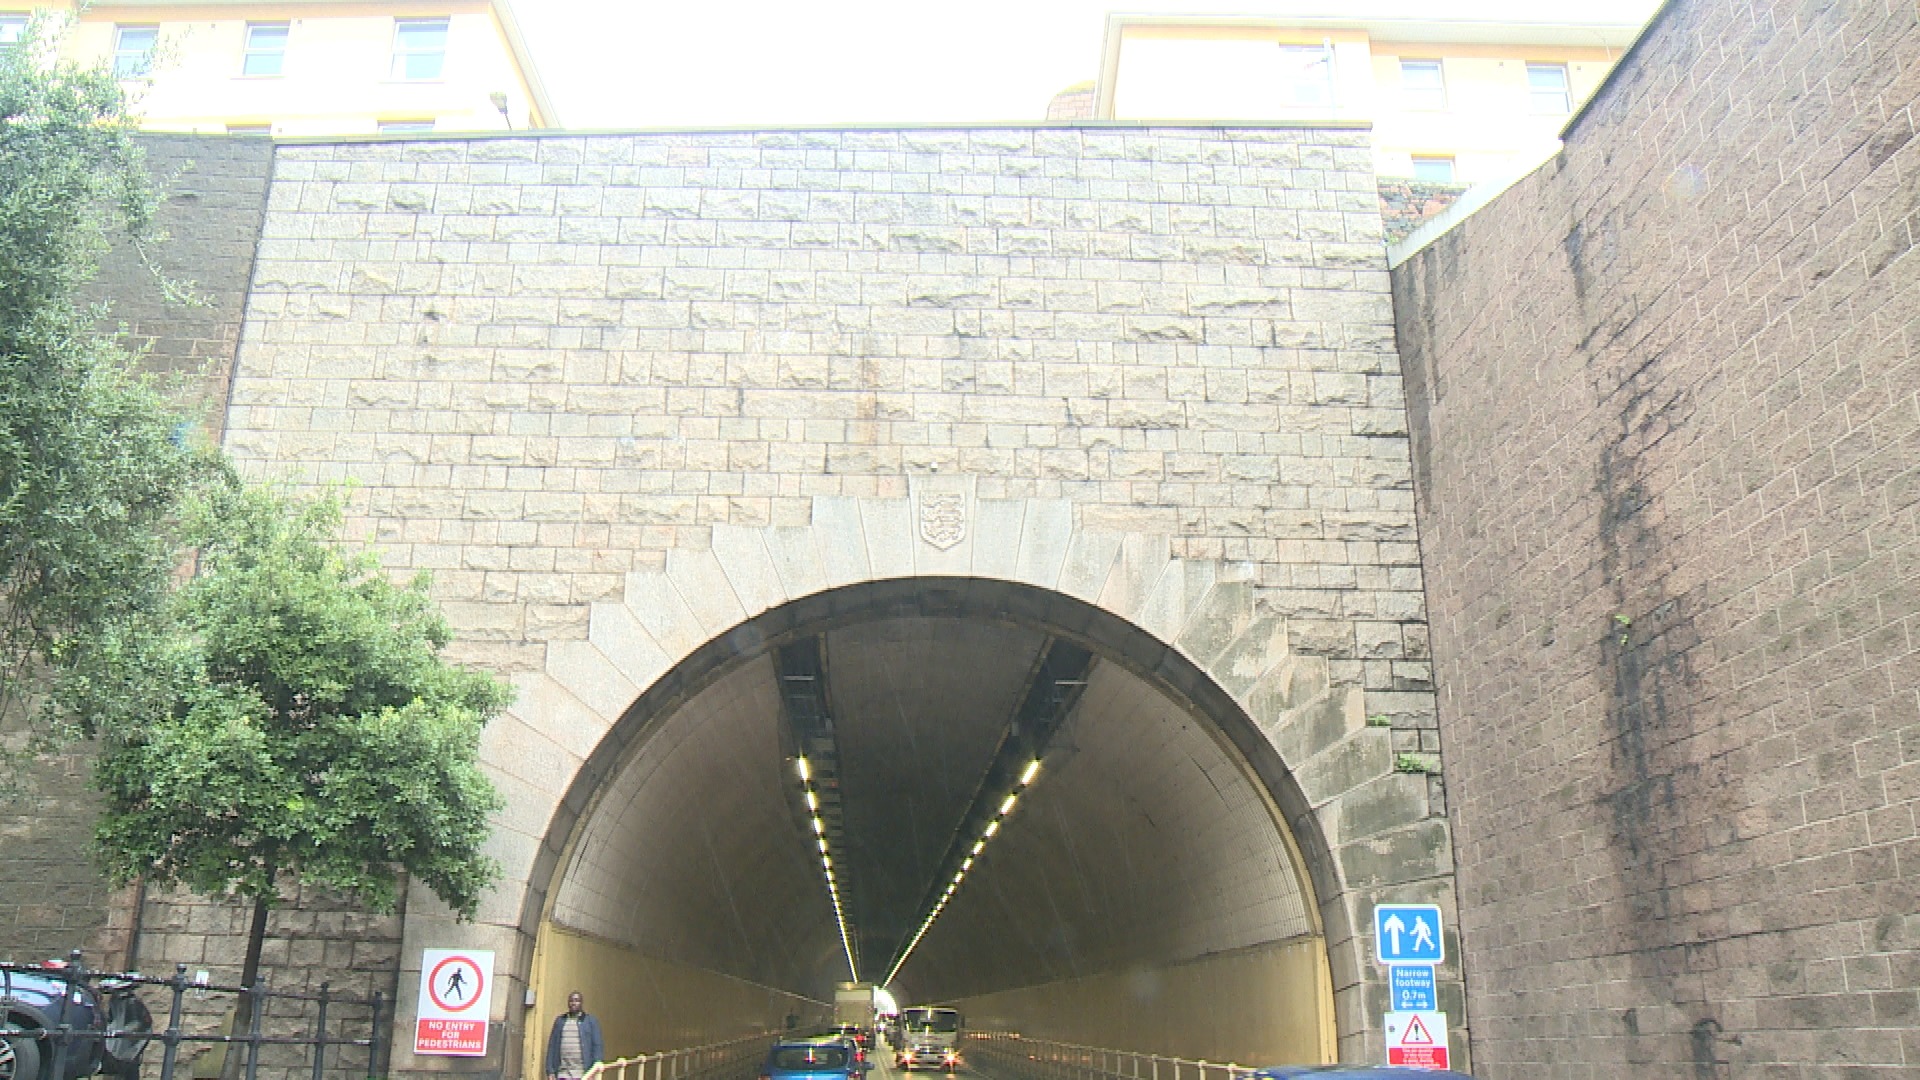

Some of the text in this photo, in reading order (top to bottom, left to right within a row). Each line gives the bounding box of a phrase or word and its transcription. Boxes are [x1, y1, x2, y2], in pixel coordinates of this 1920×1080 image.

[1396, 968, 1429, 977] Narrow
[1395, 978, 1431, 989] footway
[429, 1021, 475, 1031] NO ENTRY
[441, 1030, 460, 1039] FOR
[418, 1038, 482, 1049] PEDESTRIANS
